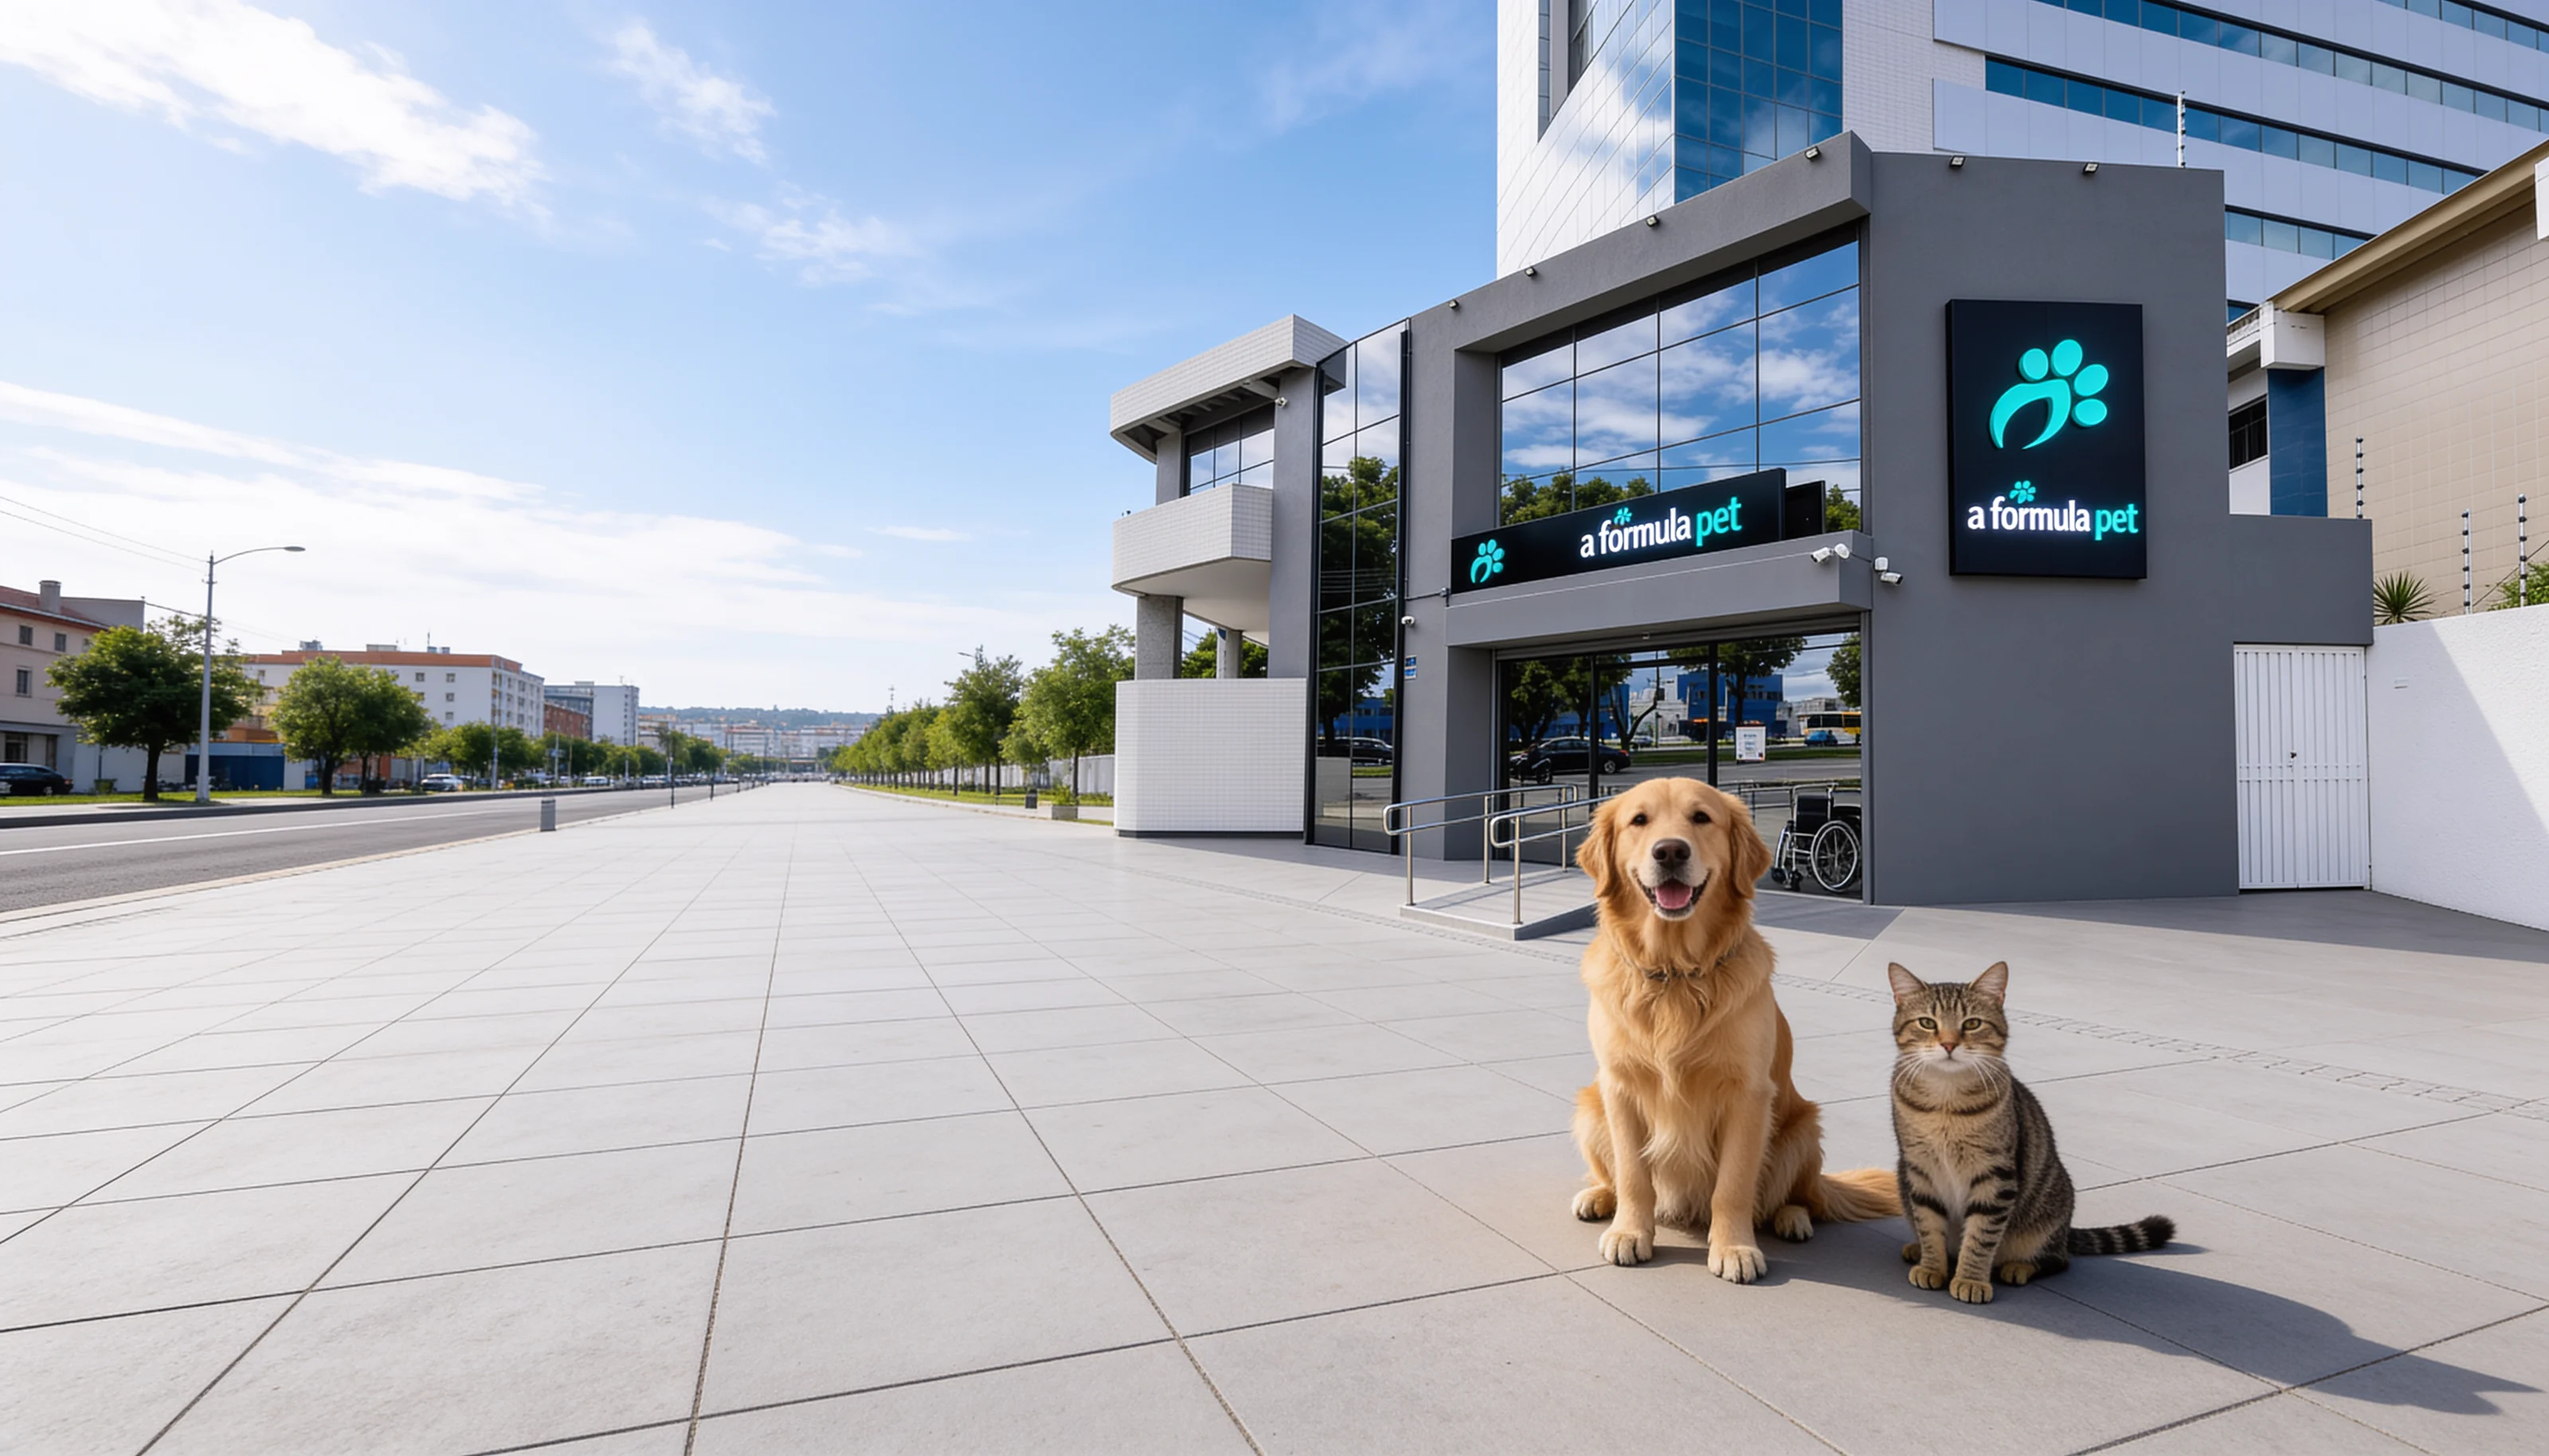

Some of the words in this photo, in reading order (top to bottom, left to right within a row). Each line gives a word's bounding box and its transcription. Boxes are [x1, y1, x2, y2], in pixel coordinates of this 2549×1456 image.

[1580, 534, 1595, 558] a
[1697, 497, 1742, 546] pet
[1968, 506, 1985, 529] a
[2096, 504, 2139, 540] pet
